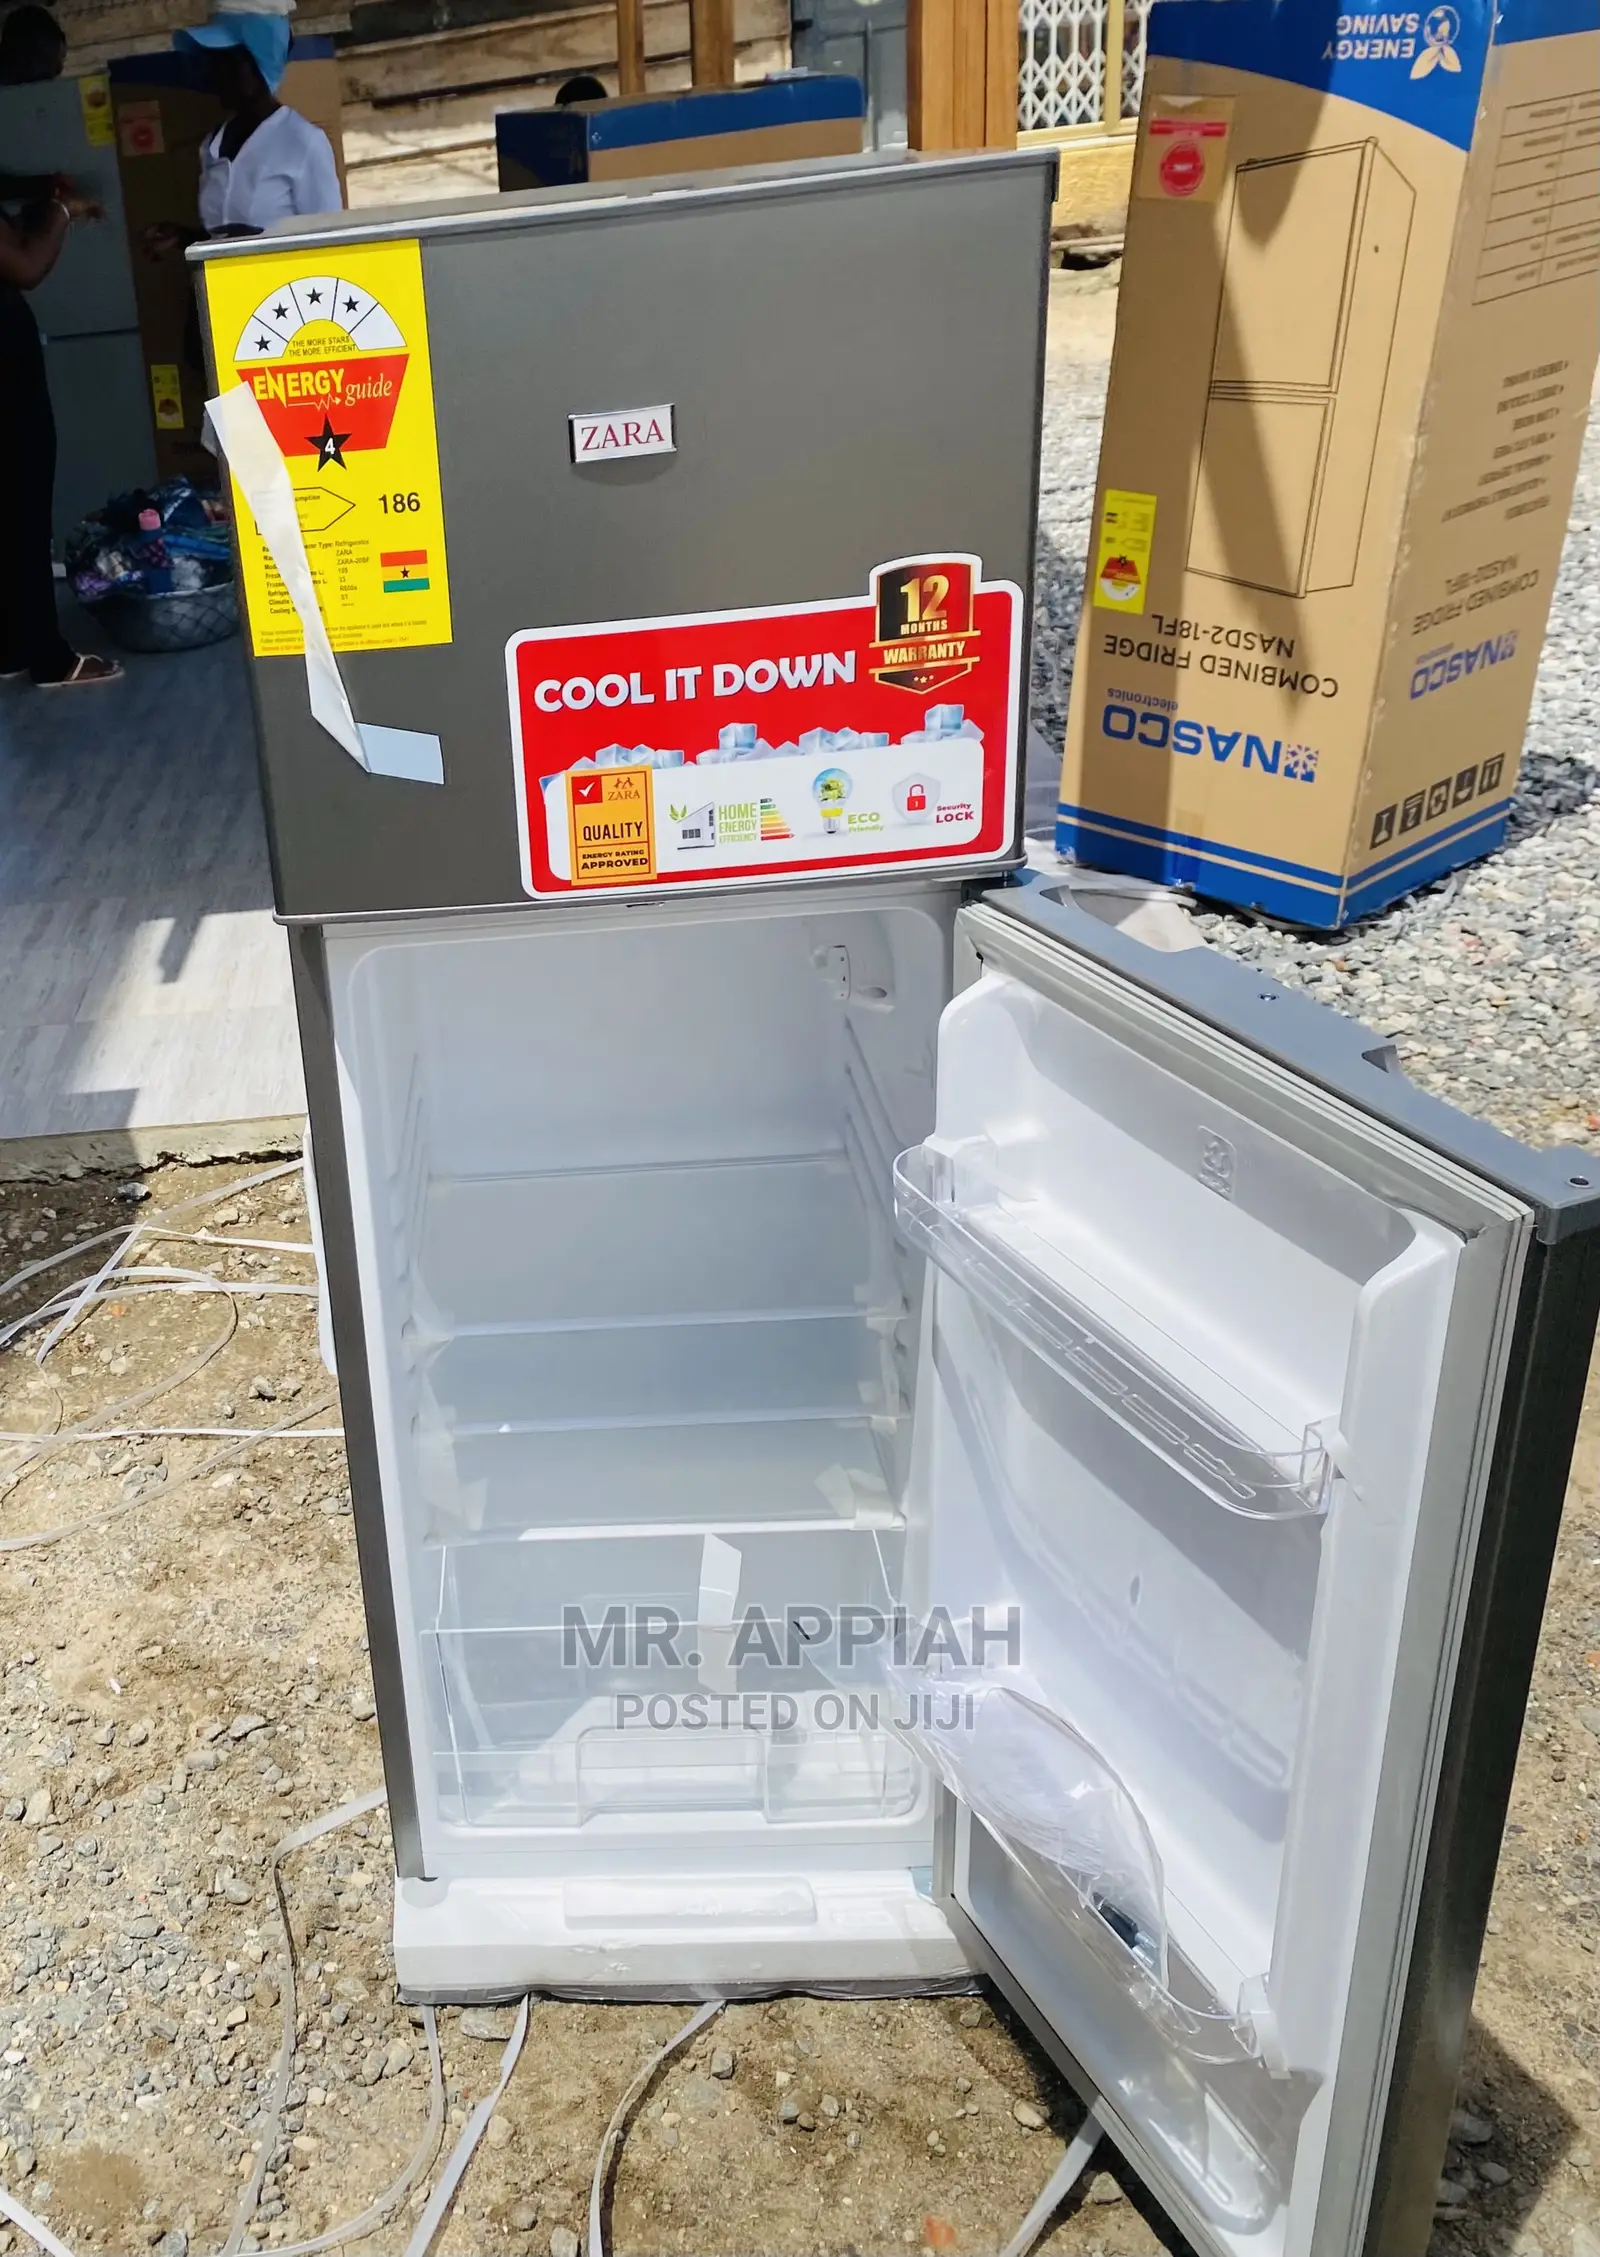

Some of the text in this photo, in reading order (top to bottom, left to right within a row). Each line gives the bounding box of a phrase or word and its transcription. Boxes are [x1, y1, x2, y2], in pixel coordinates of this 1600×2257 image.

[1336, 13, 1420, 35] SAVING
[1321, 38, 1416, 60] ENERGY
[289, 344, 356, 357] THE MORE EFFICIENT
[292, 336, 350, 348] THE MORE STARS
[253, 367, 393, 408] ENERGY guide
[581, 418, 665, 451] ZARA
[325, 437, 336, 455] 4
[379, 492, 421, 515] 186
[900, 574, 950, 622] 12
[900, 620, 948, 635] MONTHS
[1151, 614, 1296, 660] NASD2-18FL
[883, 641, 966, 664] WARRANTY
[1103, 634, 1339, 698] COMBINED FRIDGE
[1410, 635, 1502, 700] NASCO
[534, 650, 856, 713] COOL IT DOWN
[1107, 687, 1179, 711] electronics
[1102, 703, 1283, 775] NASCO
[608, 789, 641, 801] ZARA
[718, 803, 757, 820] HOME
[936, 802, 972, 812] Security
[936, 811, 974, 824] LOCK
[718, 819, 757, 833] ENERGY
[847, 811, 881, 825] ECO
[583, 821, 643, 842] QUALITY
[581, 857, 648, 870] APPROVED
[582, 849, 645, 860] ENERGY RATING
